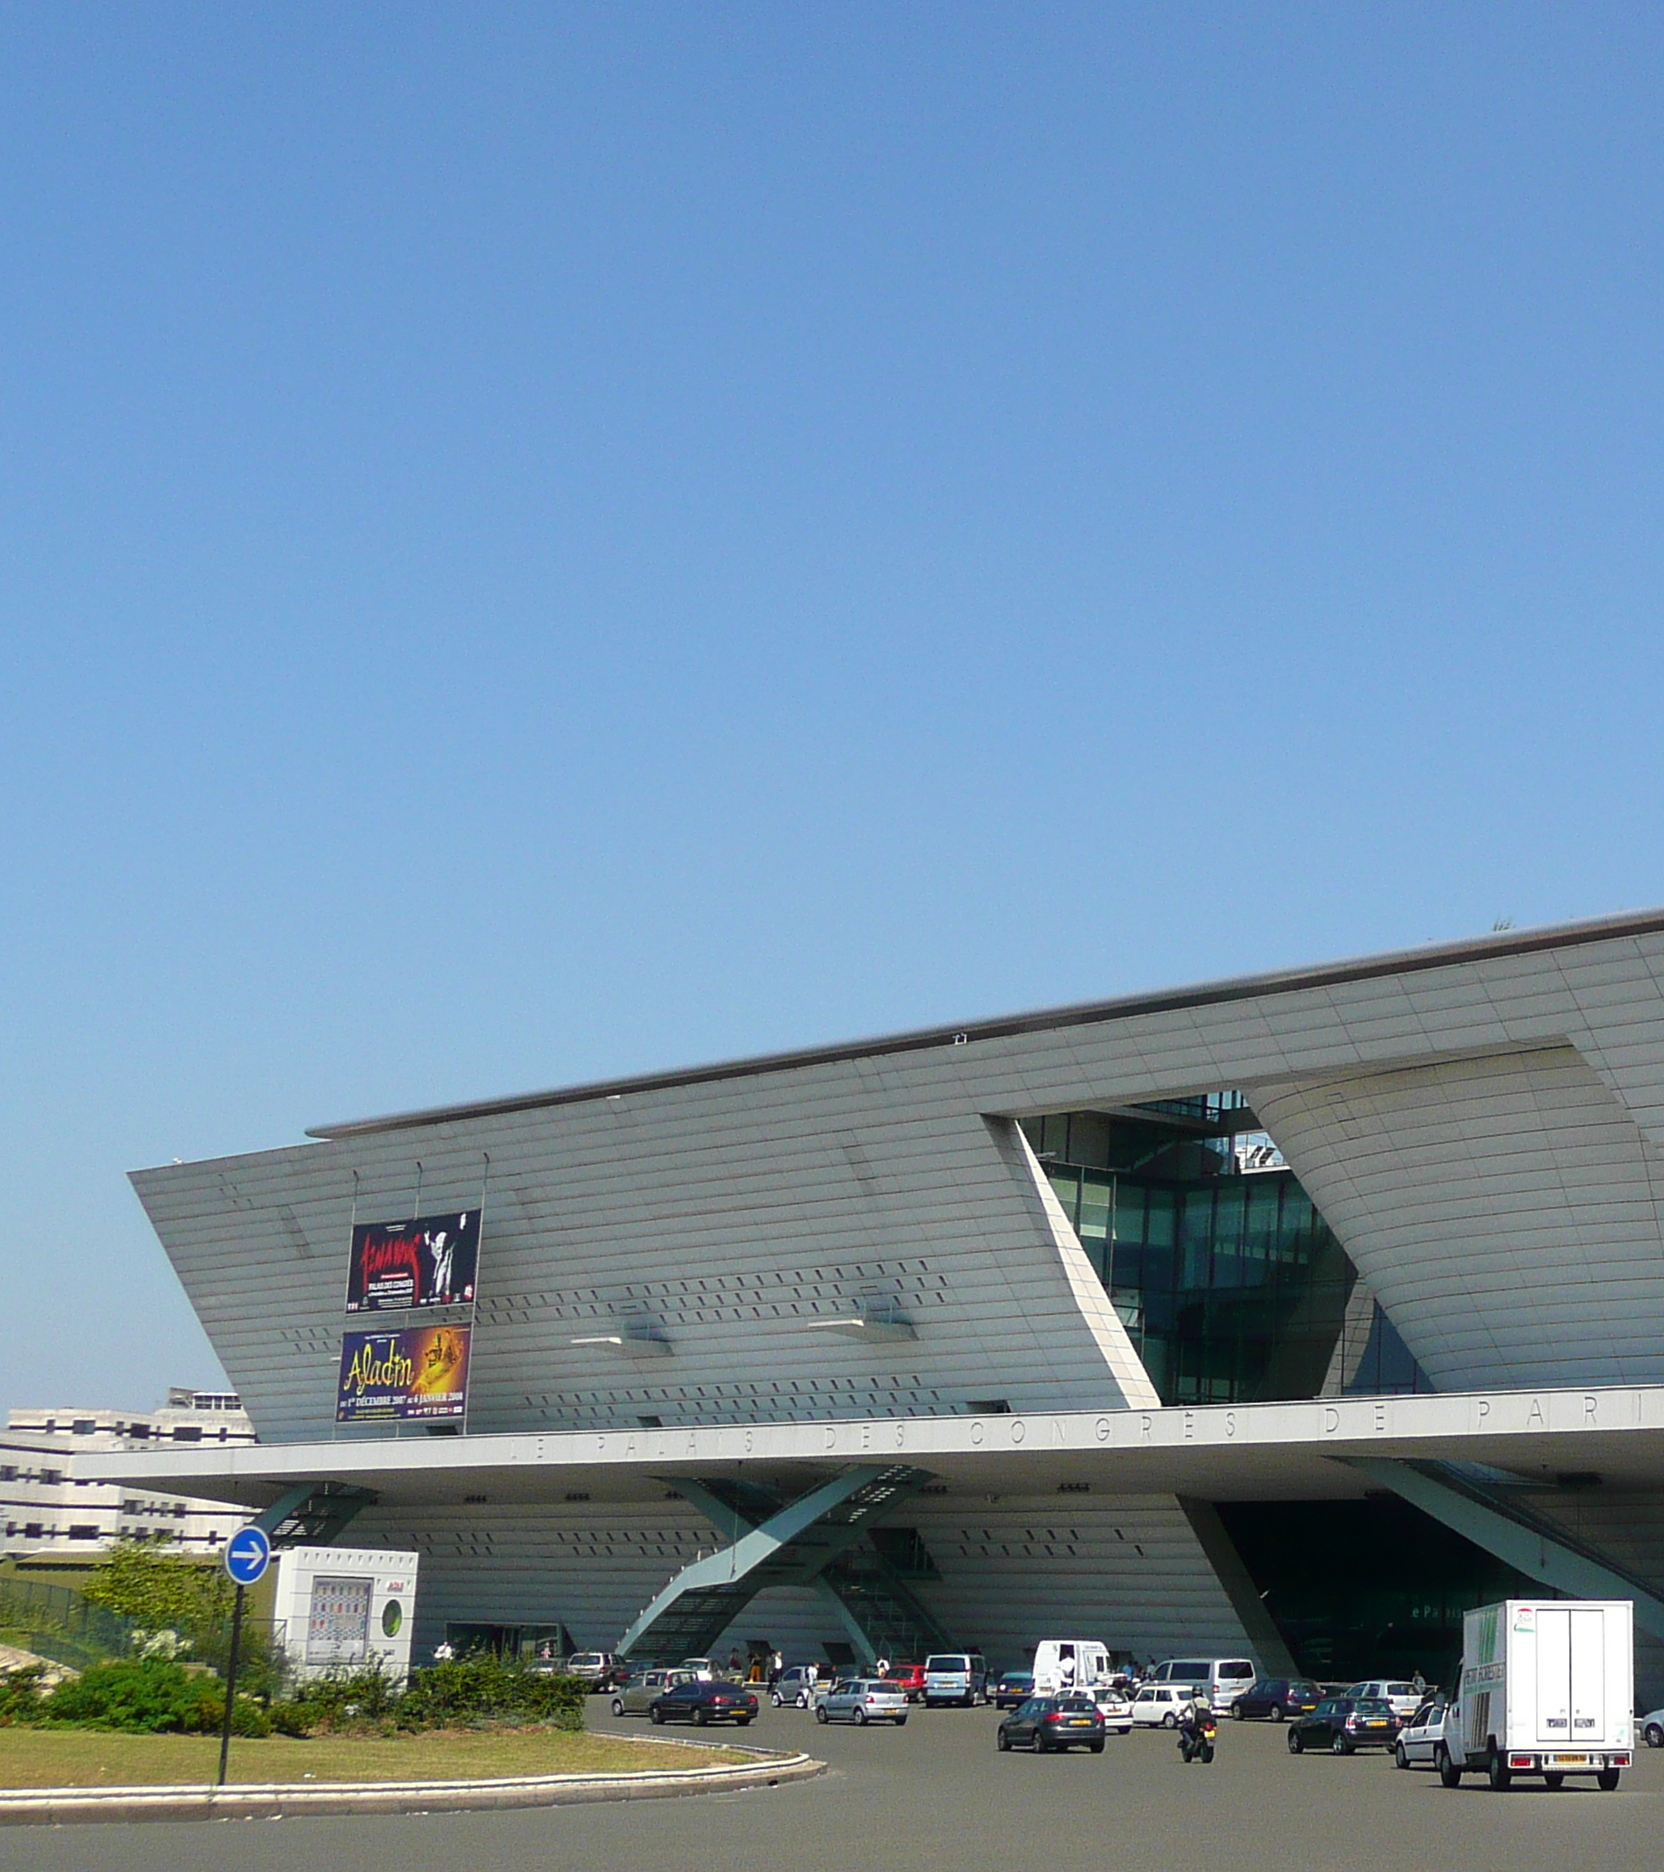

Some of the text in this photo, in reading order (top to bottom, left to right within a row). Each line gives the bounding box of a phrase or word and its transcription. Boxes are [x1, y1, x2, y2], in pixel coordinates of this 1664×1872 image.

[344, 1339, 414, 1396] Aladin
[598, 1431, 753, 1457] PALAIS
[825, 1424, 904, 1449] DES
[970, 1411, 1236, 1445] CONGRÈS
[1325, 1405, 1385, 1433] DE
